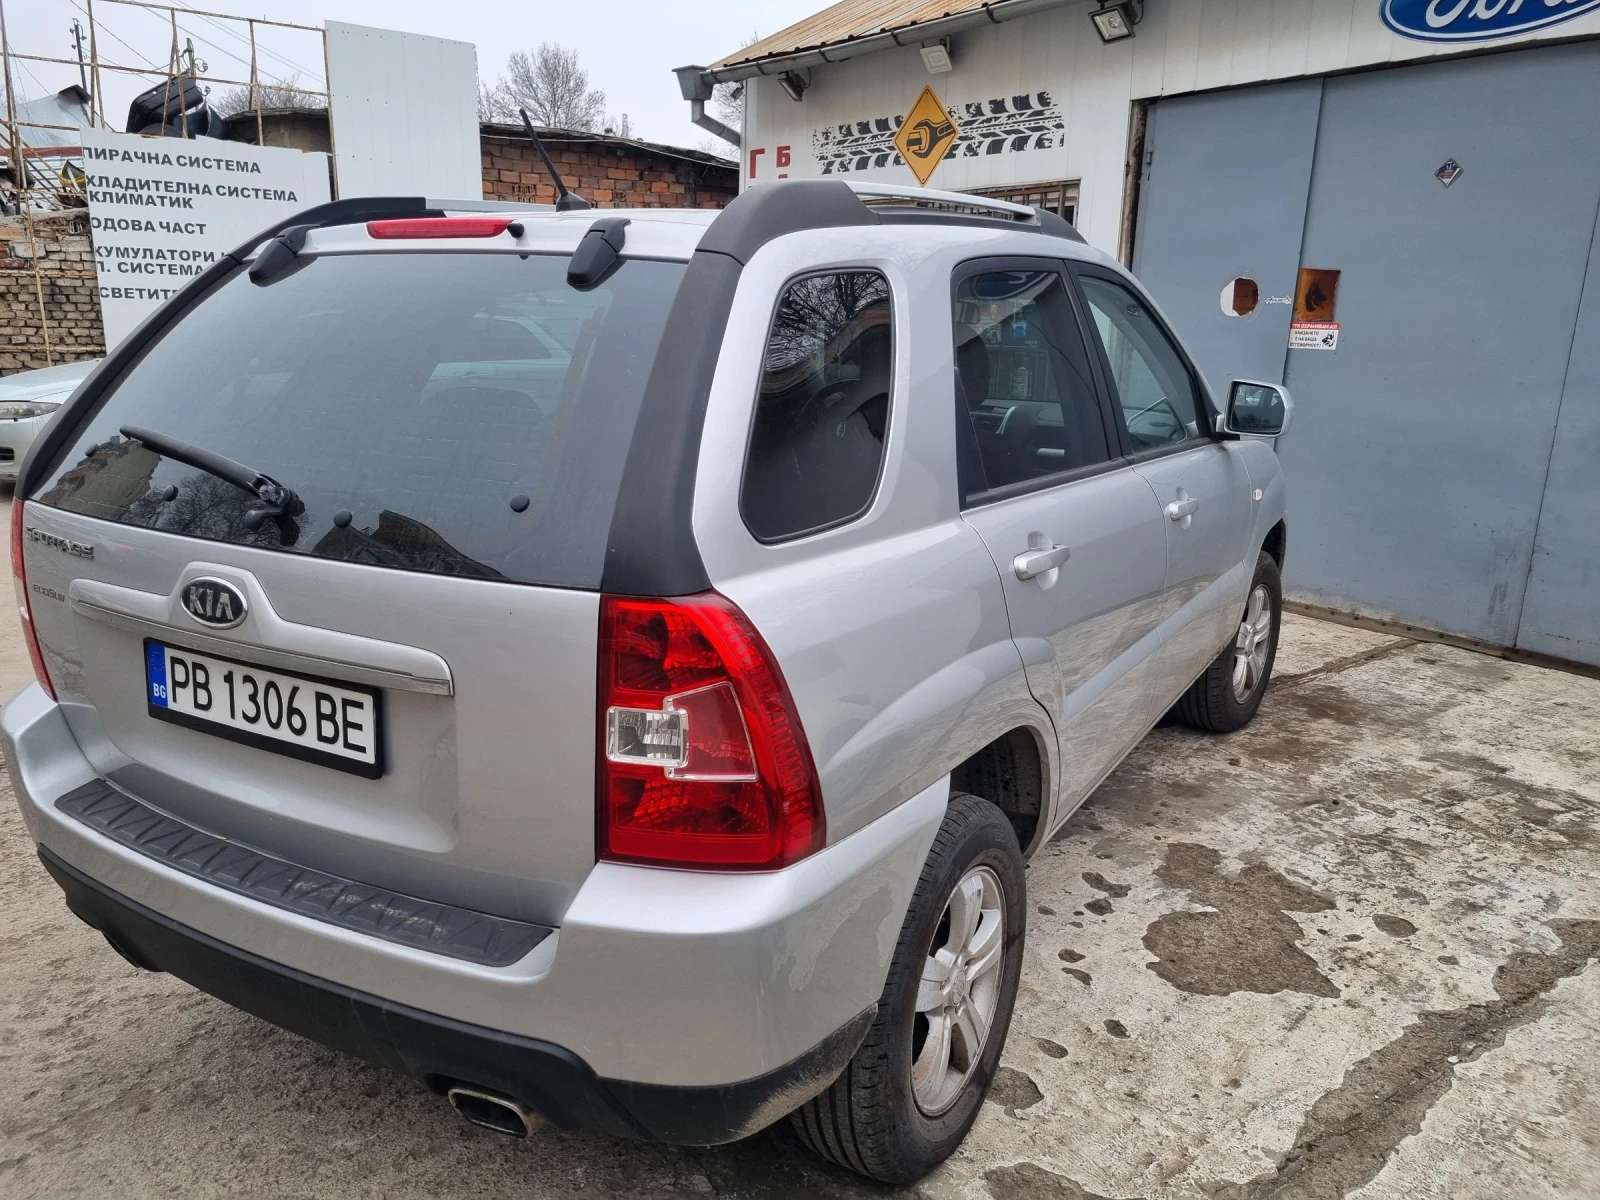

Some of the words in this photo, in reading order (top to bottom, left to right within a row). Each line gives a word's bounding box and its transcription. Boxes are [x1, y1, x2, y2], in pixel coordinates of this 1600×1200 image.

[83, 147, 173, 166] ПИРАЧНА
[176, 155, 262, 174] СИСТЕМА
[86, 175, 213, 196] ХЛАДИТЕЛНА
[216, 185, 298, 202] СИСТЕМА
[89, 190, 194, 209] КЛИМАТИК
[92, 217, 156, 233] ОДОВА
[159, 221, 207, 235] ЧАСТ
[95, 245, 215, 263] КУМУЛАТОРИ
[117, 262, 204, 276] СИСТЕМА
[100, 286, 178, 300] СВЕТИТ
[189, 586, 234, 620] KIA
[153, 683, 167, 699] BG
[170, 656, 213, 712] PB
[224, 670, 308, 737] 1306
[315, 691, 368, 754] BE
